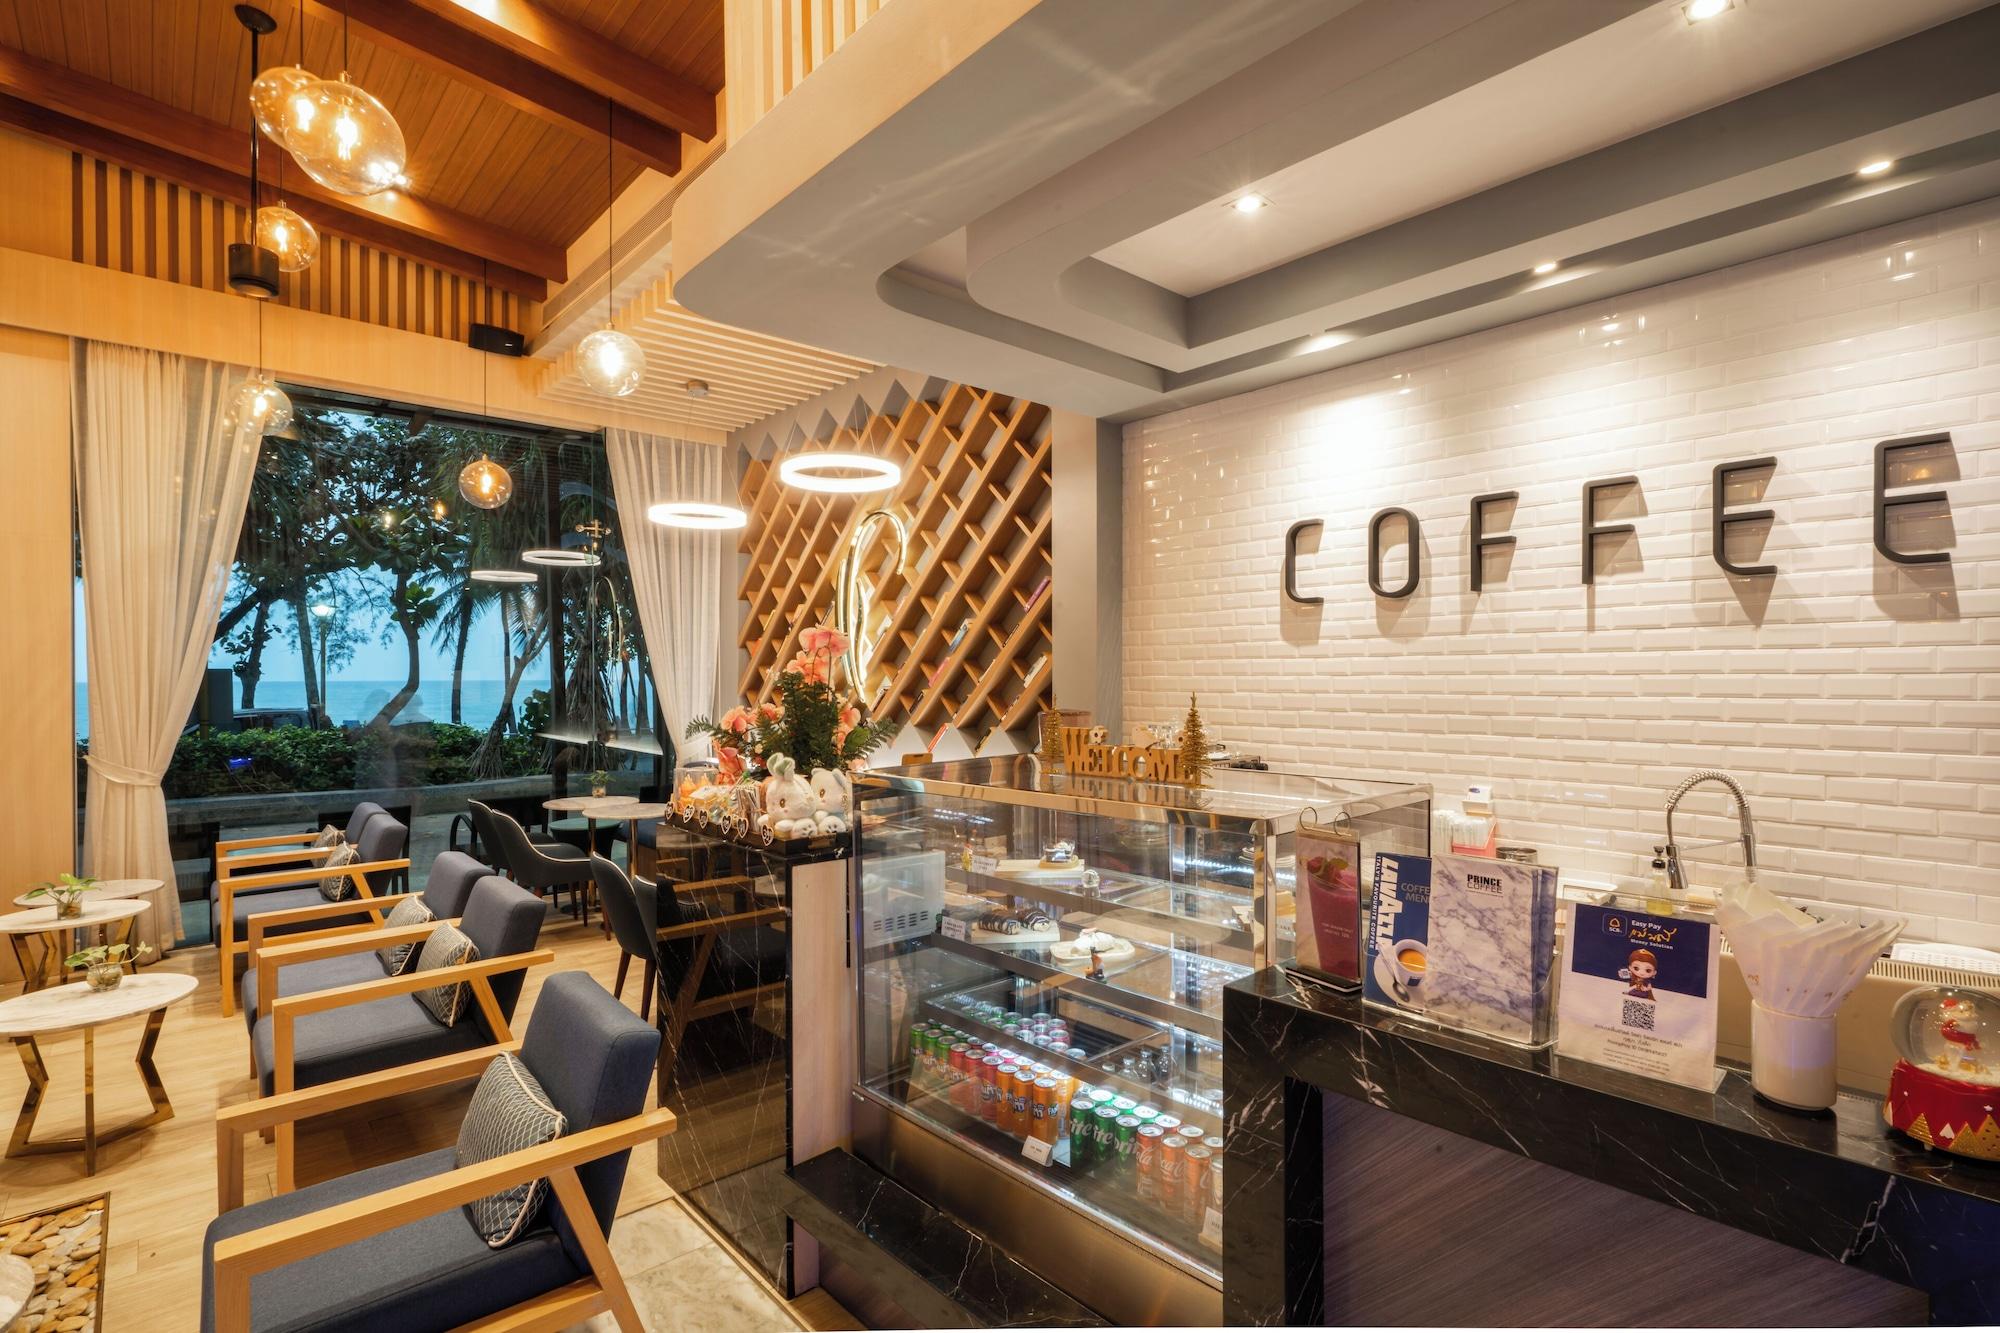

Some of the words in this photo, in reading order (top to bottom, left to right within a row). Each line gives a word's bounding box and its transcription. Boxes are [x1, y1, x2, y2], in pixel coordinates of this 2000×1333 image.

[1285, 431, 1952, 605] COFFEE
[1374, 856, 1382, 881] ITALY'S
[1467, 873, 1503, 887] PRINCE
[1401, 882, 1431, 896] COFFE
[1467, 881, 1503, 895] COFFEE
[1370, 882, 1381, 921] FAVOURITE
[1405, 892, 1430, 904] MEN
[1631, 920, 1648, 929] Easy
[1648, 923, 1662, 931] Pay
[1368, 921, 1377, 950] COFFEE
[1630, 938, 1648, 947] Money
[1649, 942, 1674, 950] Solution
